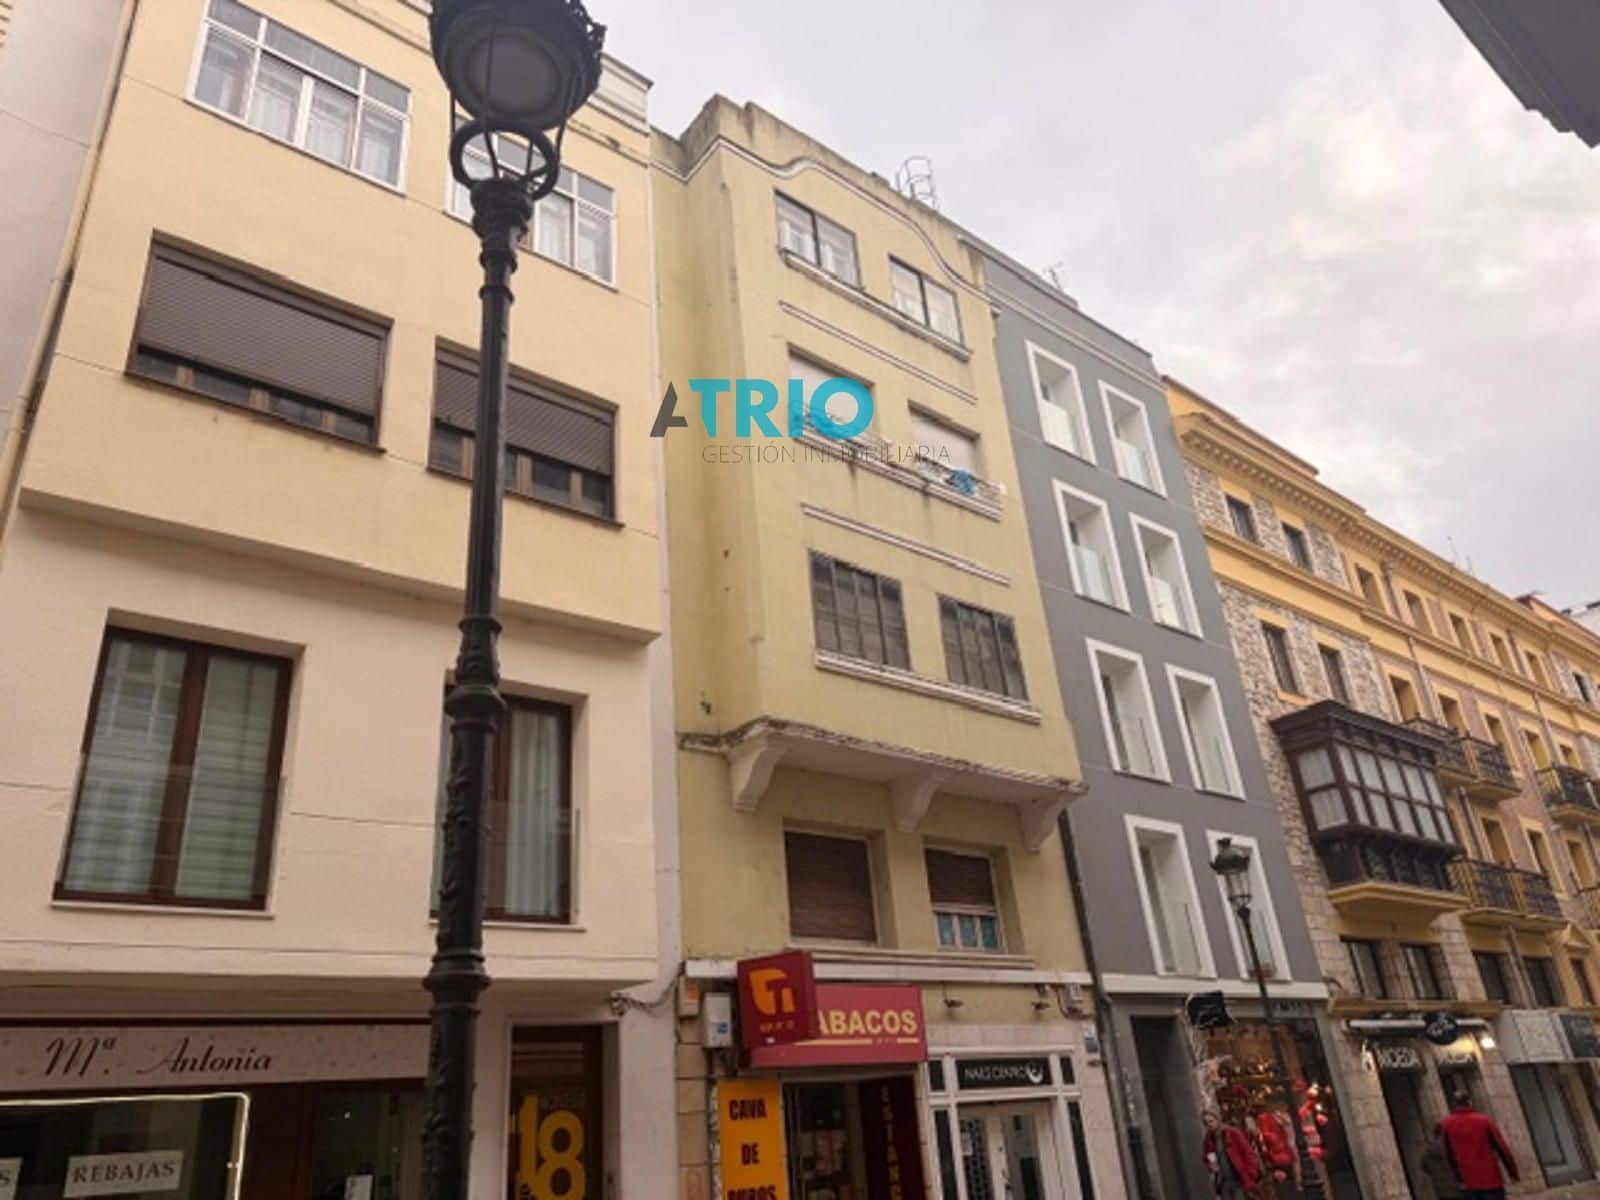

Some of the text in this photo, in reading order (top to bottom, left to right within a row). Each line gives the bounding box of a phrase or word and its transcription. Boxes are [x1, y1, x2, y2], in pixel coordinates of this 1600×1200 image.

[136, 1036, 272, 1073] Antonia
[729, 1099, 767, 1120] CAVA
[741, 1143, 759, 1165] DE
[73, 1161, 176, 1184] REBAJAS
